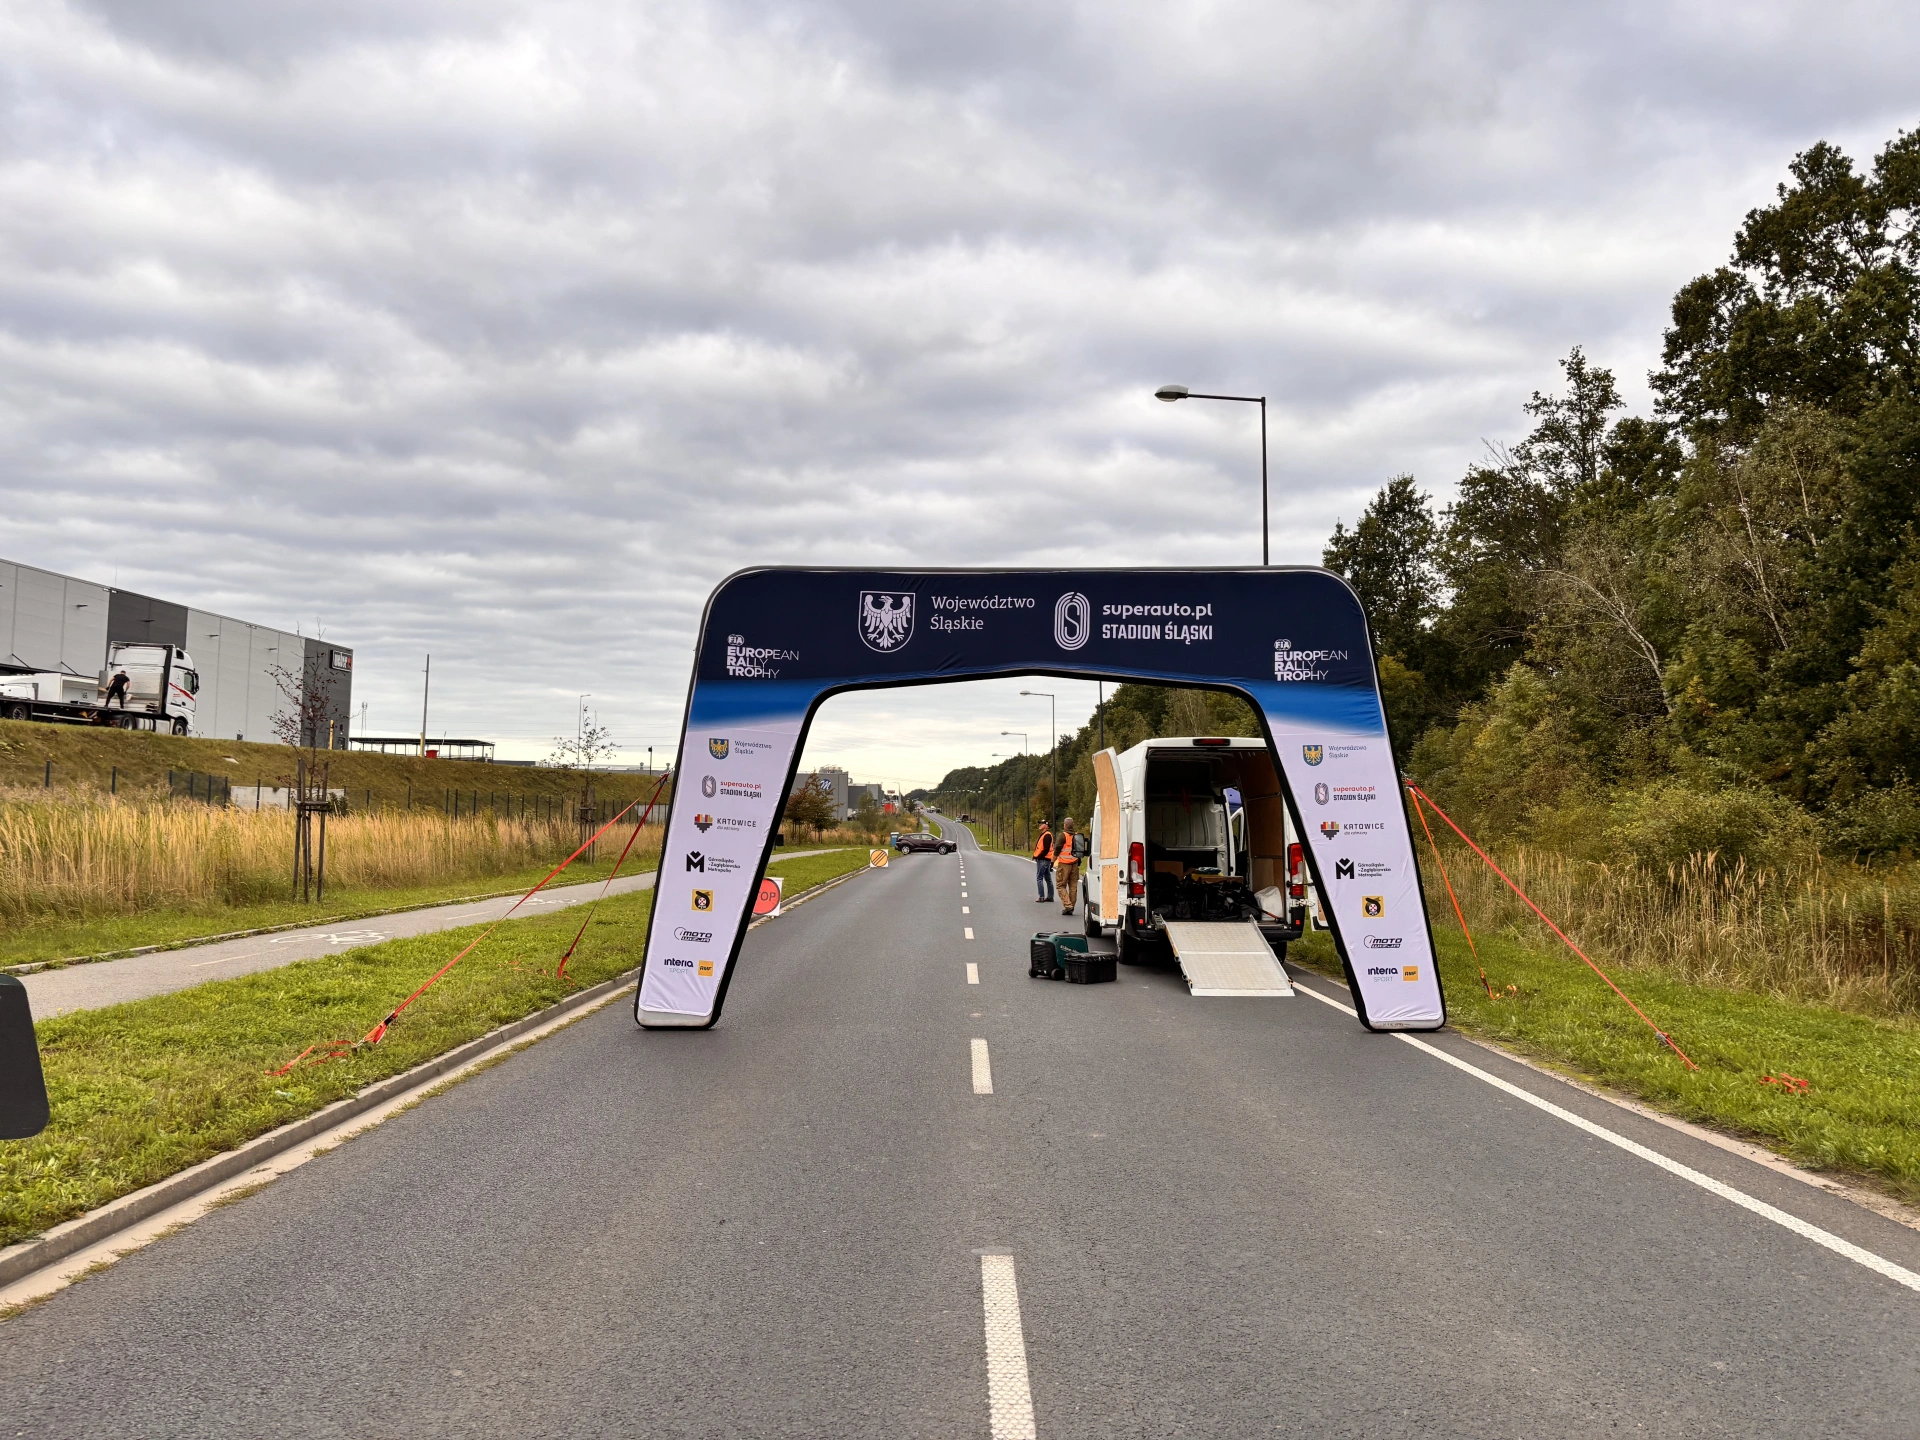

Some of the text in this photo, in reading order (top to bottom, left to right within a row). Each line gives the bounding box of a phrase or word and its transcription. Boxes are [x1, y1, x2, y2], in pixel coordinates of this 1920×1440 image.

[931, 595, 1035, 612] Województwo
[1102, 602, 1213, 620] superauto.pl
[930, 615, 984, 633] Śląskie
[1102, 621, 1213, 645] STADION ŚLĄSKI
[727, 646, 800, 660] EUROPEAN
[1274, 650, 1348, 661] EUROPEAN
[727, 656, 769, 668] RALLY
[1274, 660, 1317, 672] RALLY
[726, 665, 780, 679] TROPHY
[1274, 670, 1329, 681] TROPHY
[734, 740, 772, 749] Województwo
[720, 780, 761, 790] superauto.pl
[720, 789, 762, 799] STADION ŚLĄSKI
[1357, 793, 1376, 802] ŚLĄSKI
[717, 818, 757, 828] KATOWICE
[759, 891, 776, 901] OP
[664, 957, 694, 968] interia
[669, 967, 689, 975] SPORT
[1367, 966, 1398, 975] interia
